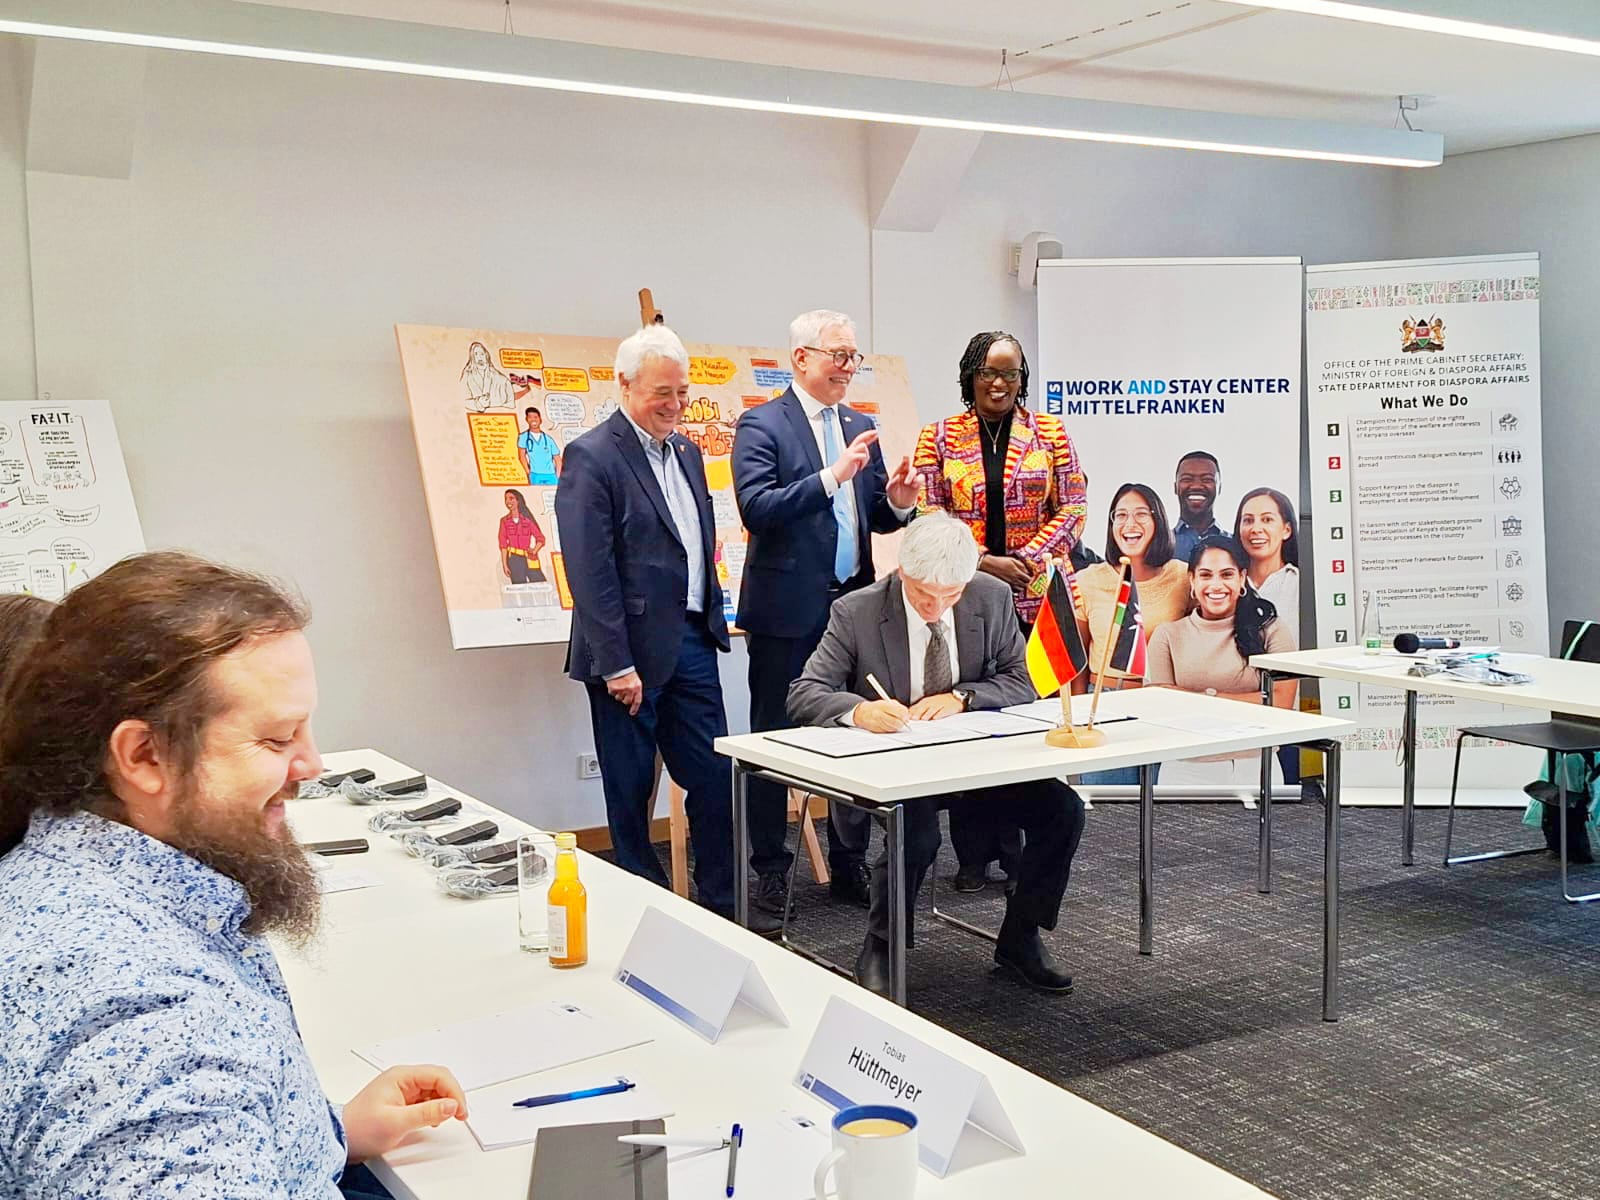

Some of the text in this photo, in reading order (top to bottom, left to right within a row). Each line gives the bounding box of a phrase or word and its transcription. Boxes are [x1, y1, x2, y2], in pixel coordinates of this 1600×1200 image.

[1324, 360, 1356, 369] OFFICE
[1374, 358, 1391, 366] THE
[1426, 355, 1467, 364] CABINET
[1469, 353, 1525, 362] SECRETARY:
[1322, 371, 1366, 380] MINISTRY
[1370, 370, 1380, 378] OF
[1385, 368, 1426, 377] FOREIGN
[1438, 364, 1486, 374] DIASPORA
[1489, 363, 1527, 372] AFFAIRS
[1066, 378, 1290, 396] WORK AND STAY CENTER
[1318, 375, 1530, 392] STATE DEPARTMENT FOR DIASPORA AFFAIRS
[1067, 398, 1225, 415] MITTELFRANKEN
[1380, 394, 1468, 409] What We Do
[882, 1042, 907, 1063] Tobias
[848, 1046, 922, 1103] Hüttmeyer
